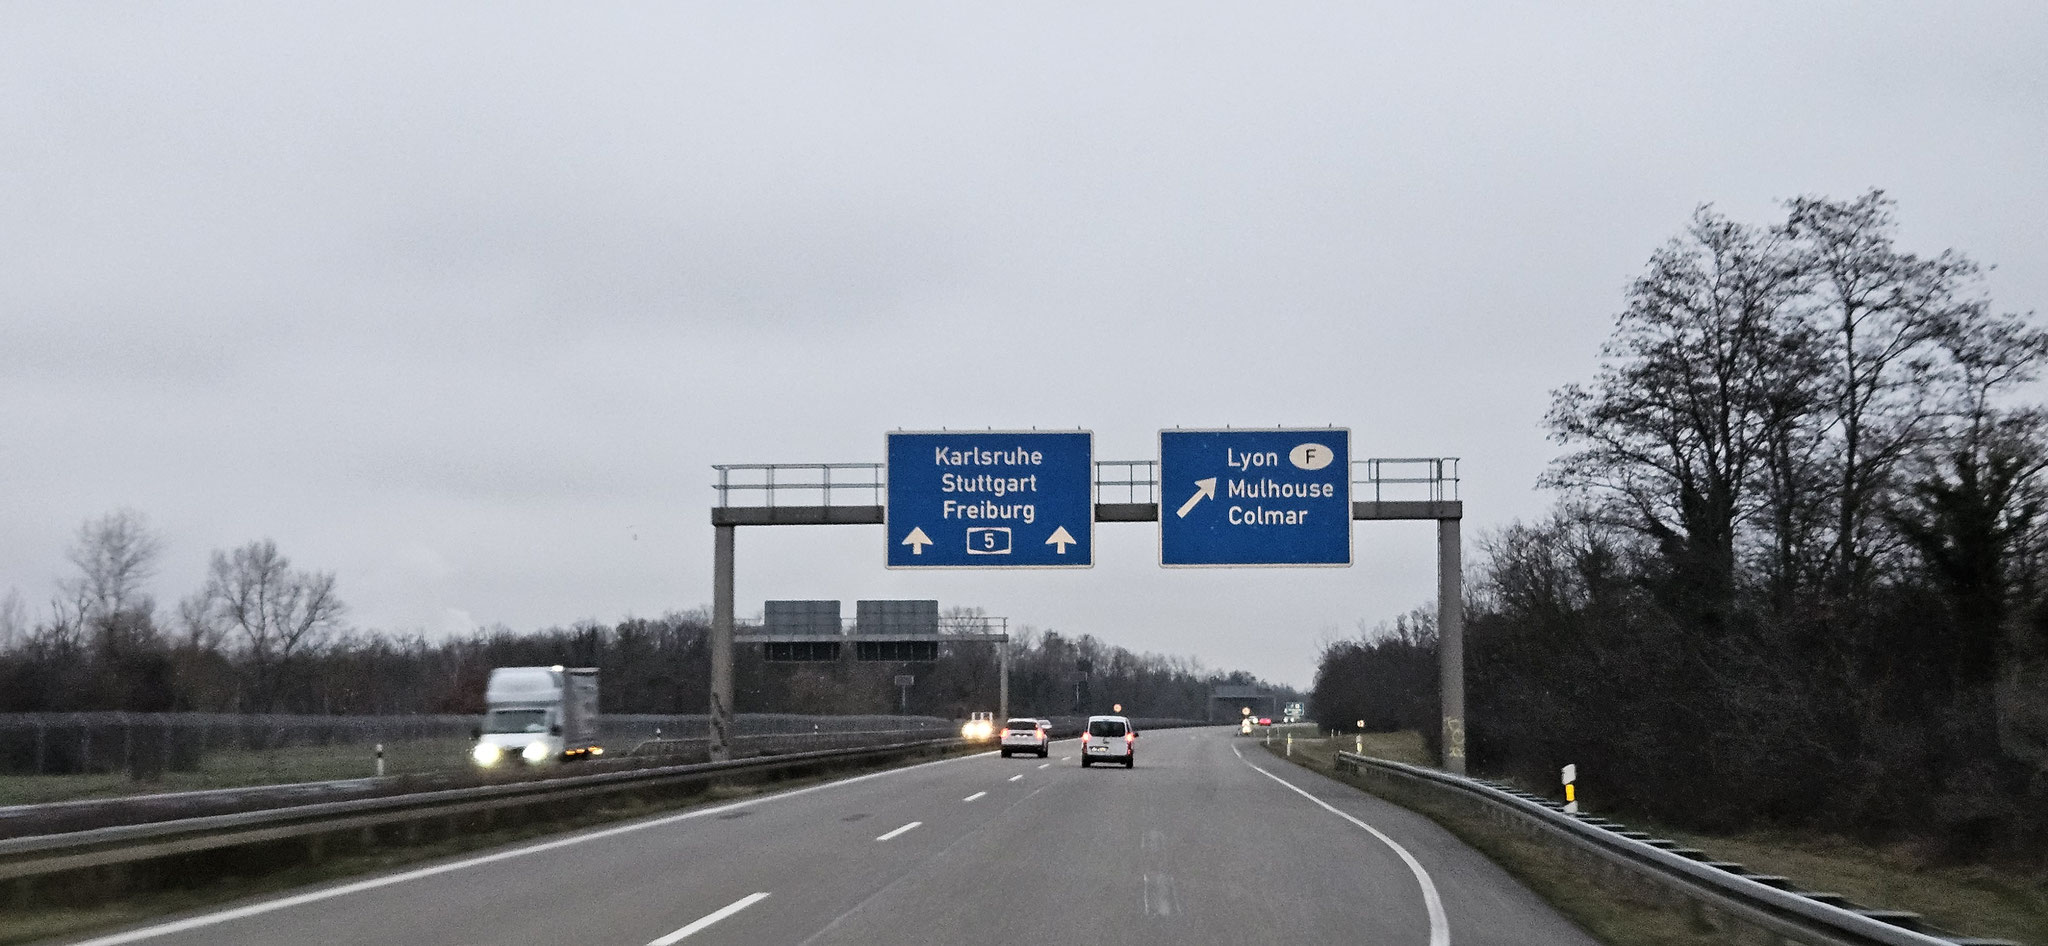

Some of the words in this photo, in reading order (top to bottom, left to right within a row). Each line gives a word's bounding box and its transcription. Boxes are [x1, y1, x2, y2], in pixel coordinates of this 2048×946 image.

[935, 446, 1043, 466] Karlsruhe
[1227, 447, 1278, 472] Lyon
[1305, 448, 1317, 465] F
[941, 473, 1037, 497] Stuttgart
[1228, 478, 1334, 499] Mulhouse
[943, 499, 1035, 524] Freiburg
[1228, 505, 1308, 525] Colmar
[983, 532, 995, 549] 5
